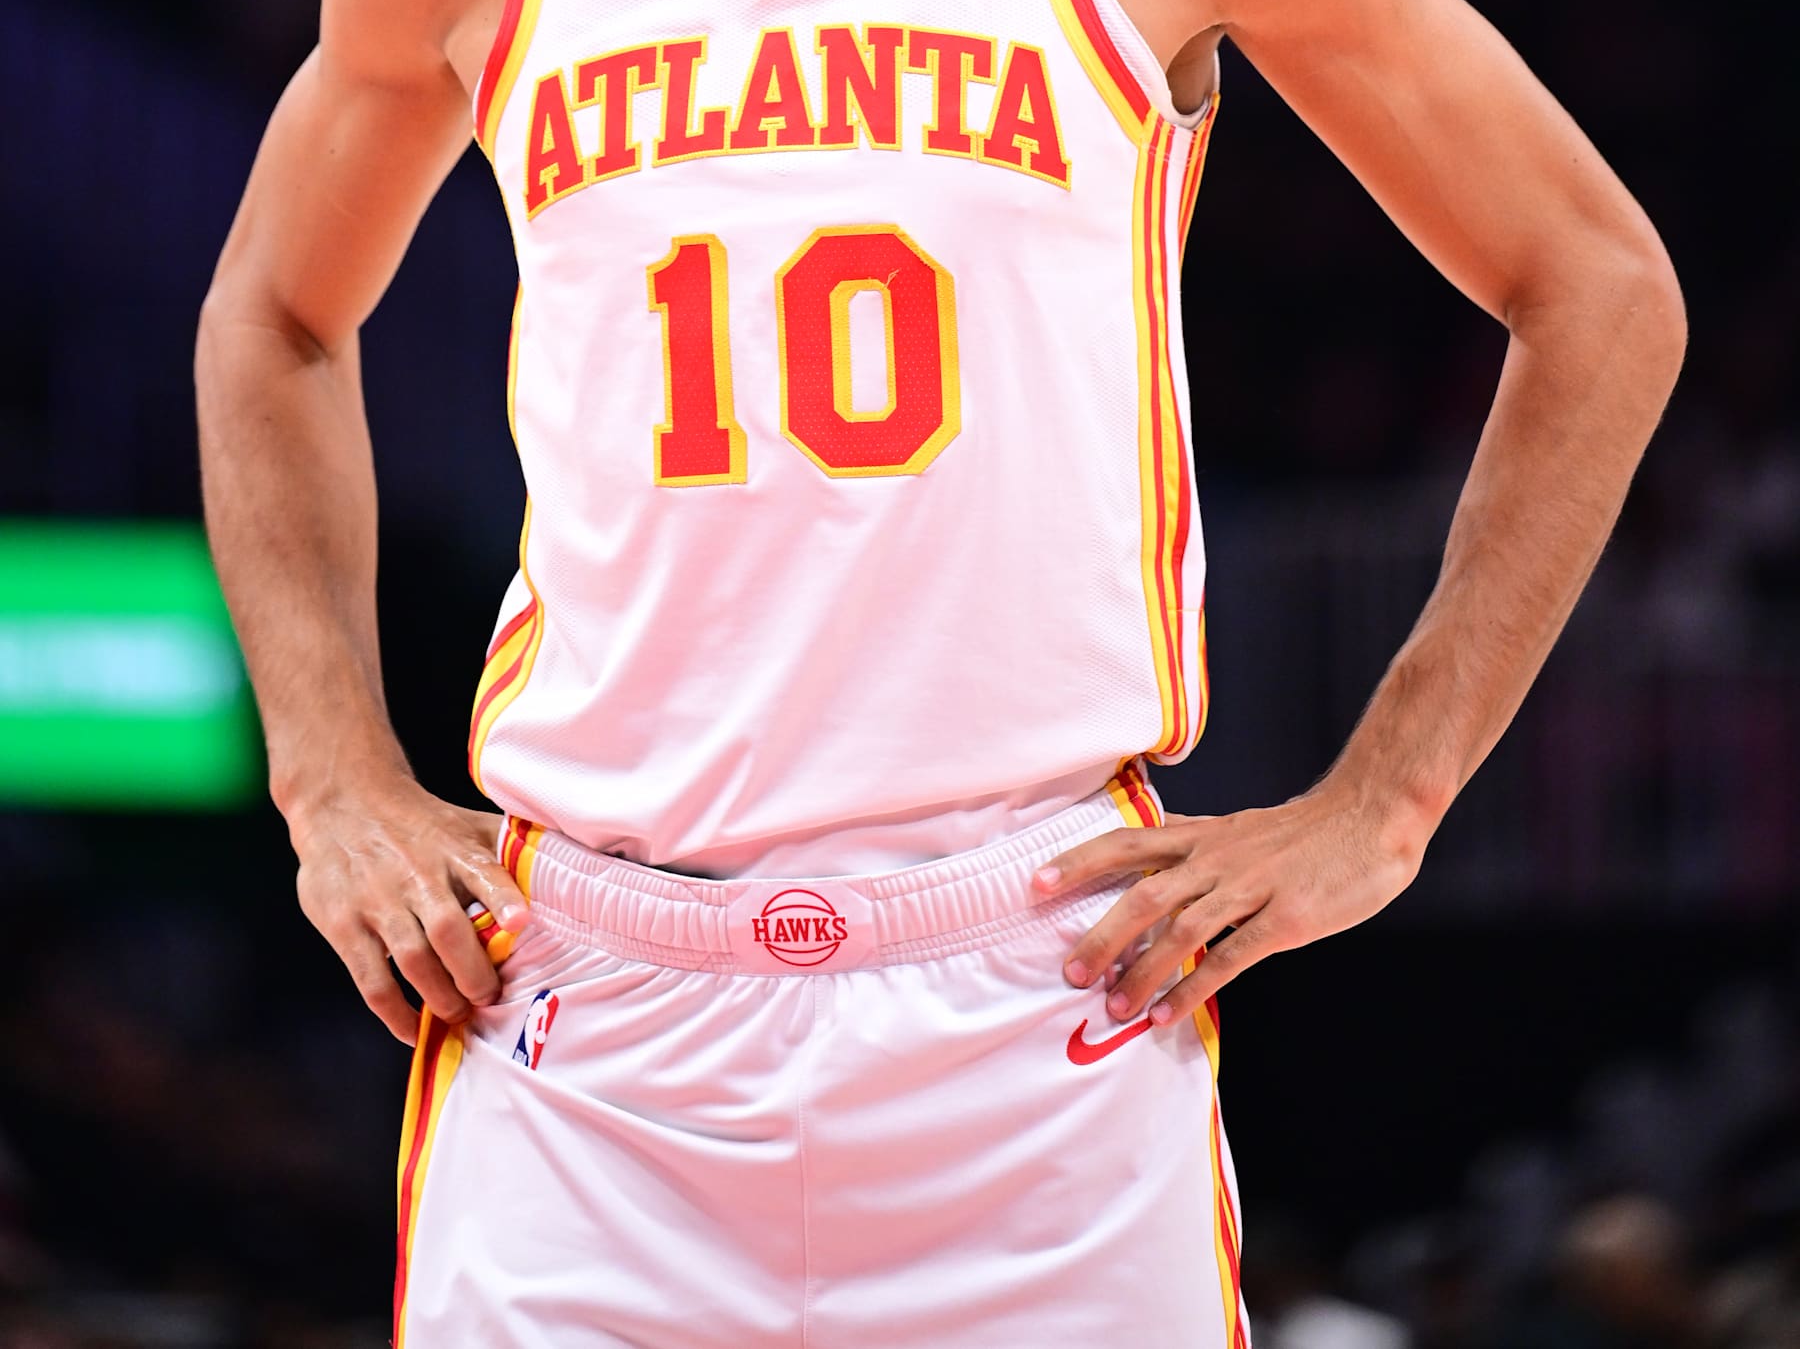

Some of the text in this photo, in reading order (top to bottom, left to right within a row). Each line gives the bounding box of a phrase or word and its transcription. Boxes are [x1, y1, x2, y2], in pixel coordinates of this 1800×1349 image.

[524, 22, 1072, 221] ATLANTA
[646, 224, 961, 487] 10
[751, 916, 848, 942] HAWKS
